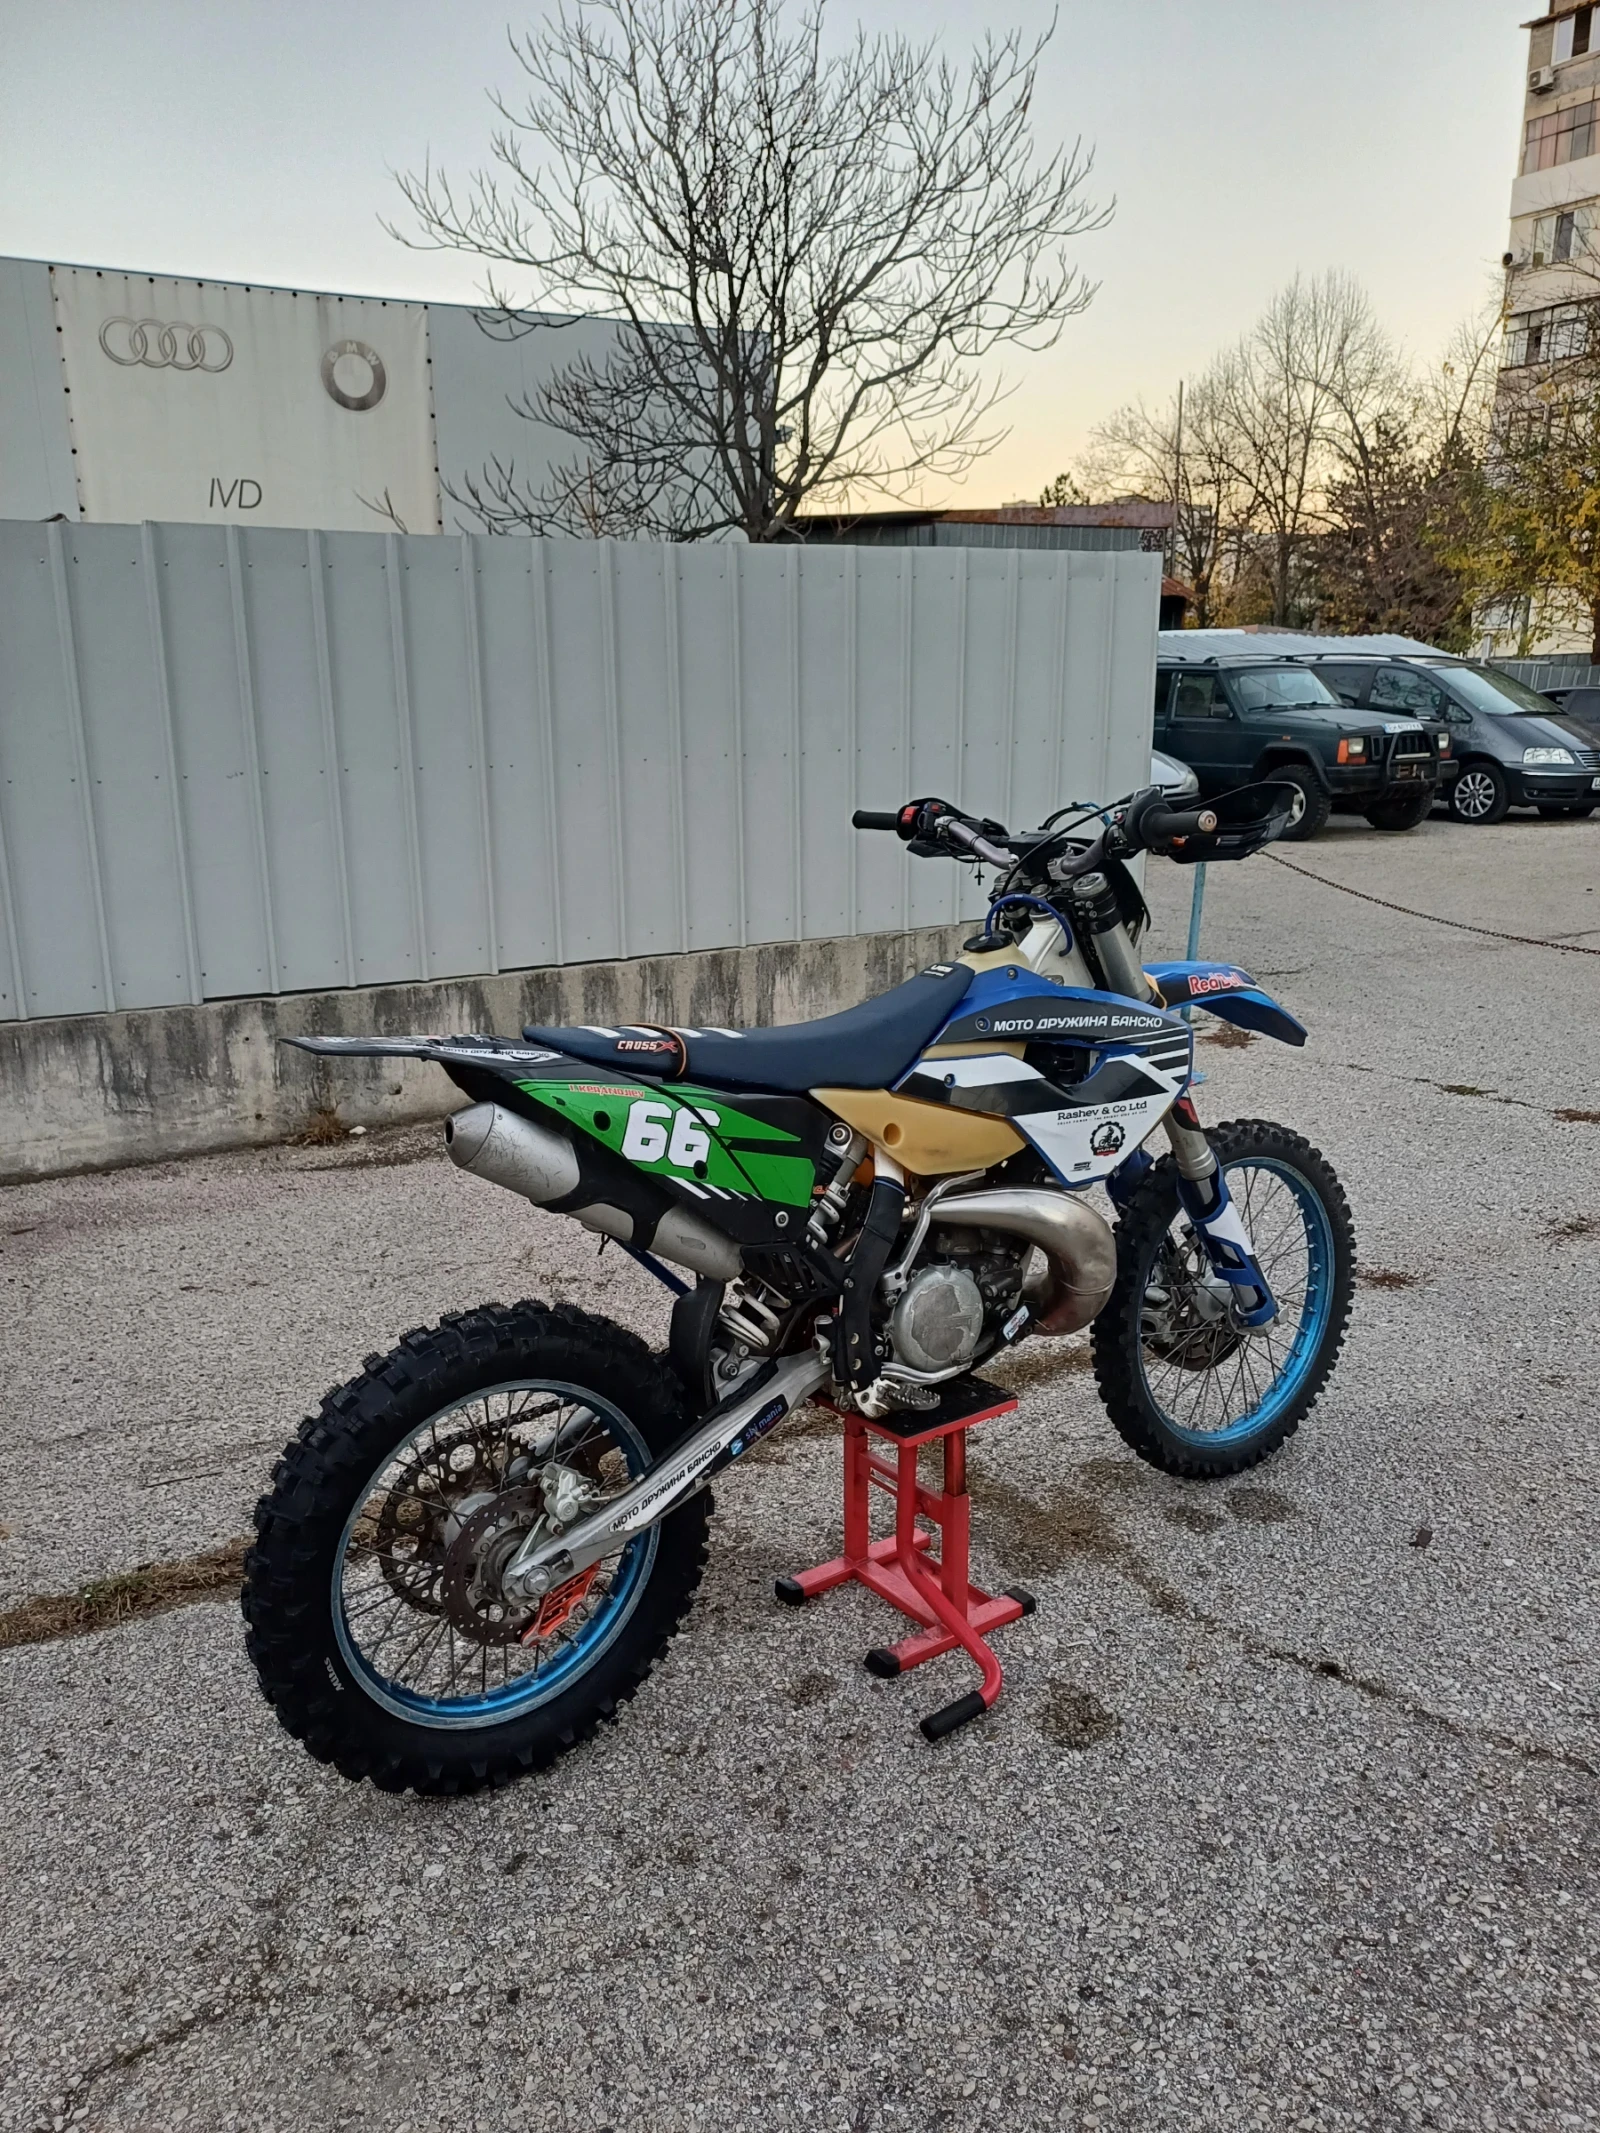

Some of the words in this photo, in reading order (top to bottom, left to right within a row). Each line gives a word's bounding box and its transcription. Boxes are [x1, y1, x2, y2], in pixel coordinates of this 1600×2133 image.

[326, 341, 380, 366] BMW
[209, 477, 263, 509] IVD
[1188, 972, 1220, 995] Red
[993, 1018, 1034, 1032] МОТО
[1036, 1015, 1108, 1030] ДРУЖИНА
[1111, 1015, 1163, 1028] БАНСКО
[1057, 1109, 1099, 1121] Rashev
[1101, 1106, 1110, 1115] &
[1112, 1105, 1127, 1114] Co
[1129, 1100, 1147, 1111] Ltd
[620, 1099, 722, 1169] 66
[758, 1404, 783, 1429] mania
[612, 1506, 640, 1532] МОТО
[641, 1469, 686, 1511] ДРУЖИНА
[686, 1441, 722, 1473] БАНСКО
